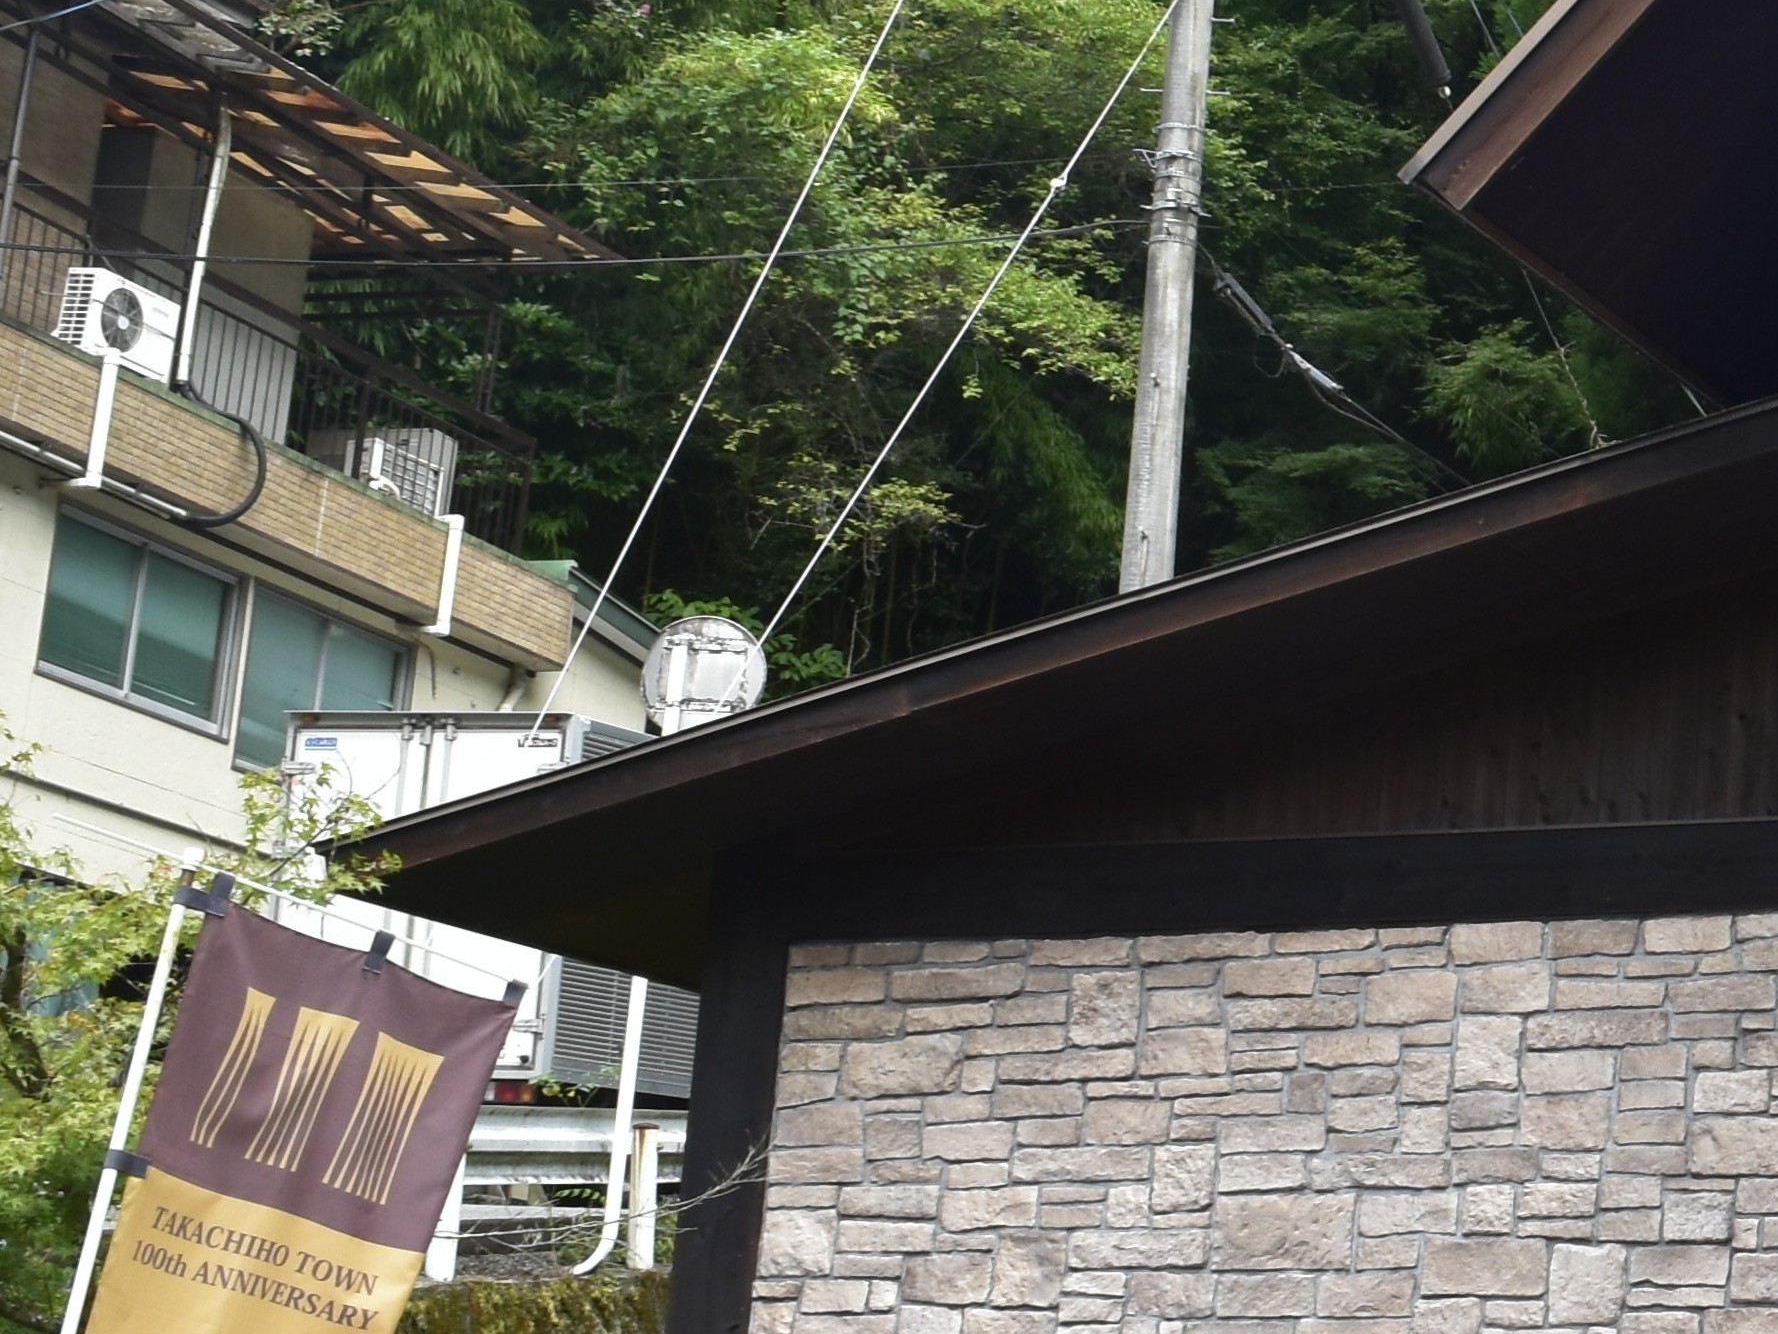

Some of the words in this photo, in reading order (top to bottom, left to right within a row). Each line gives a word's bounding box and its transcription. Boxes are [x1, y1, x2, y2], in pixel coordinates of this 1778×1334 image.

[132, 1239, 188, 1277] 100th
[192, 1261, 379, 1331] ANNIVERSARY
[151, 1206, 289, 1267] TAKACHIHO
[296, 1251, 379, 1296] TOWN
